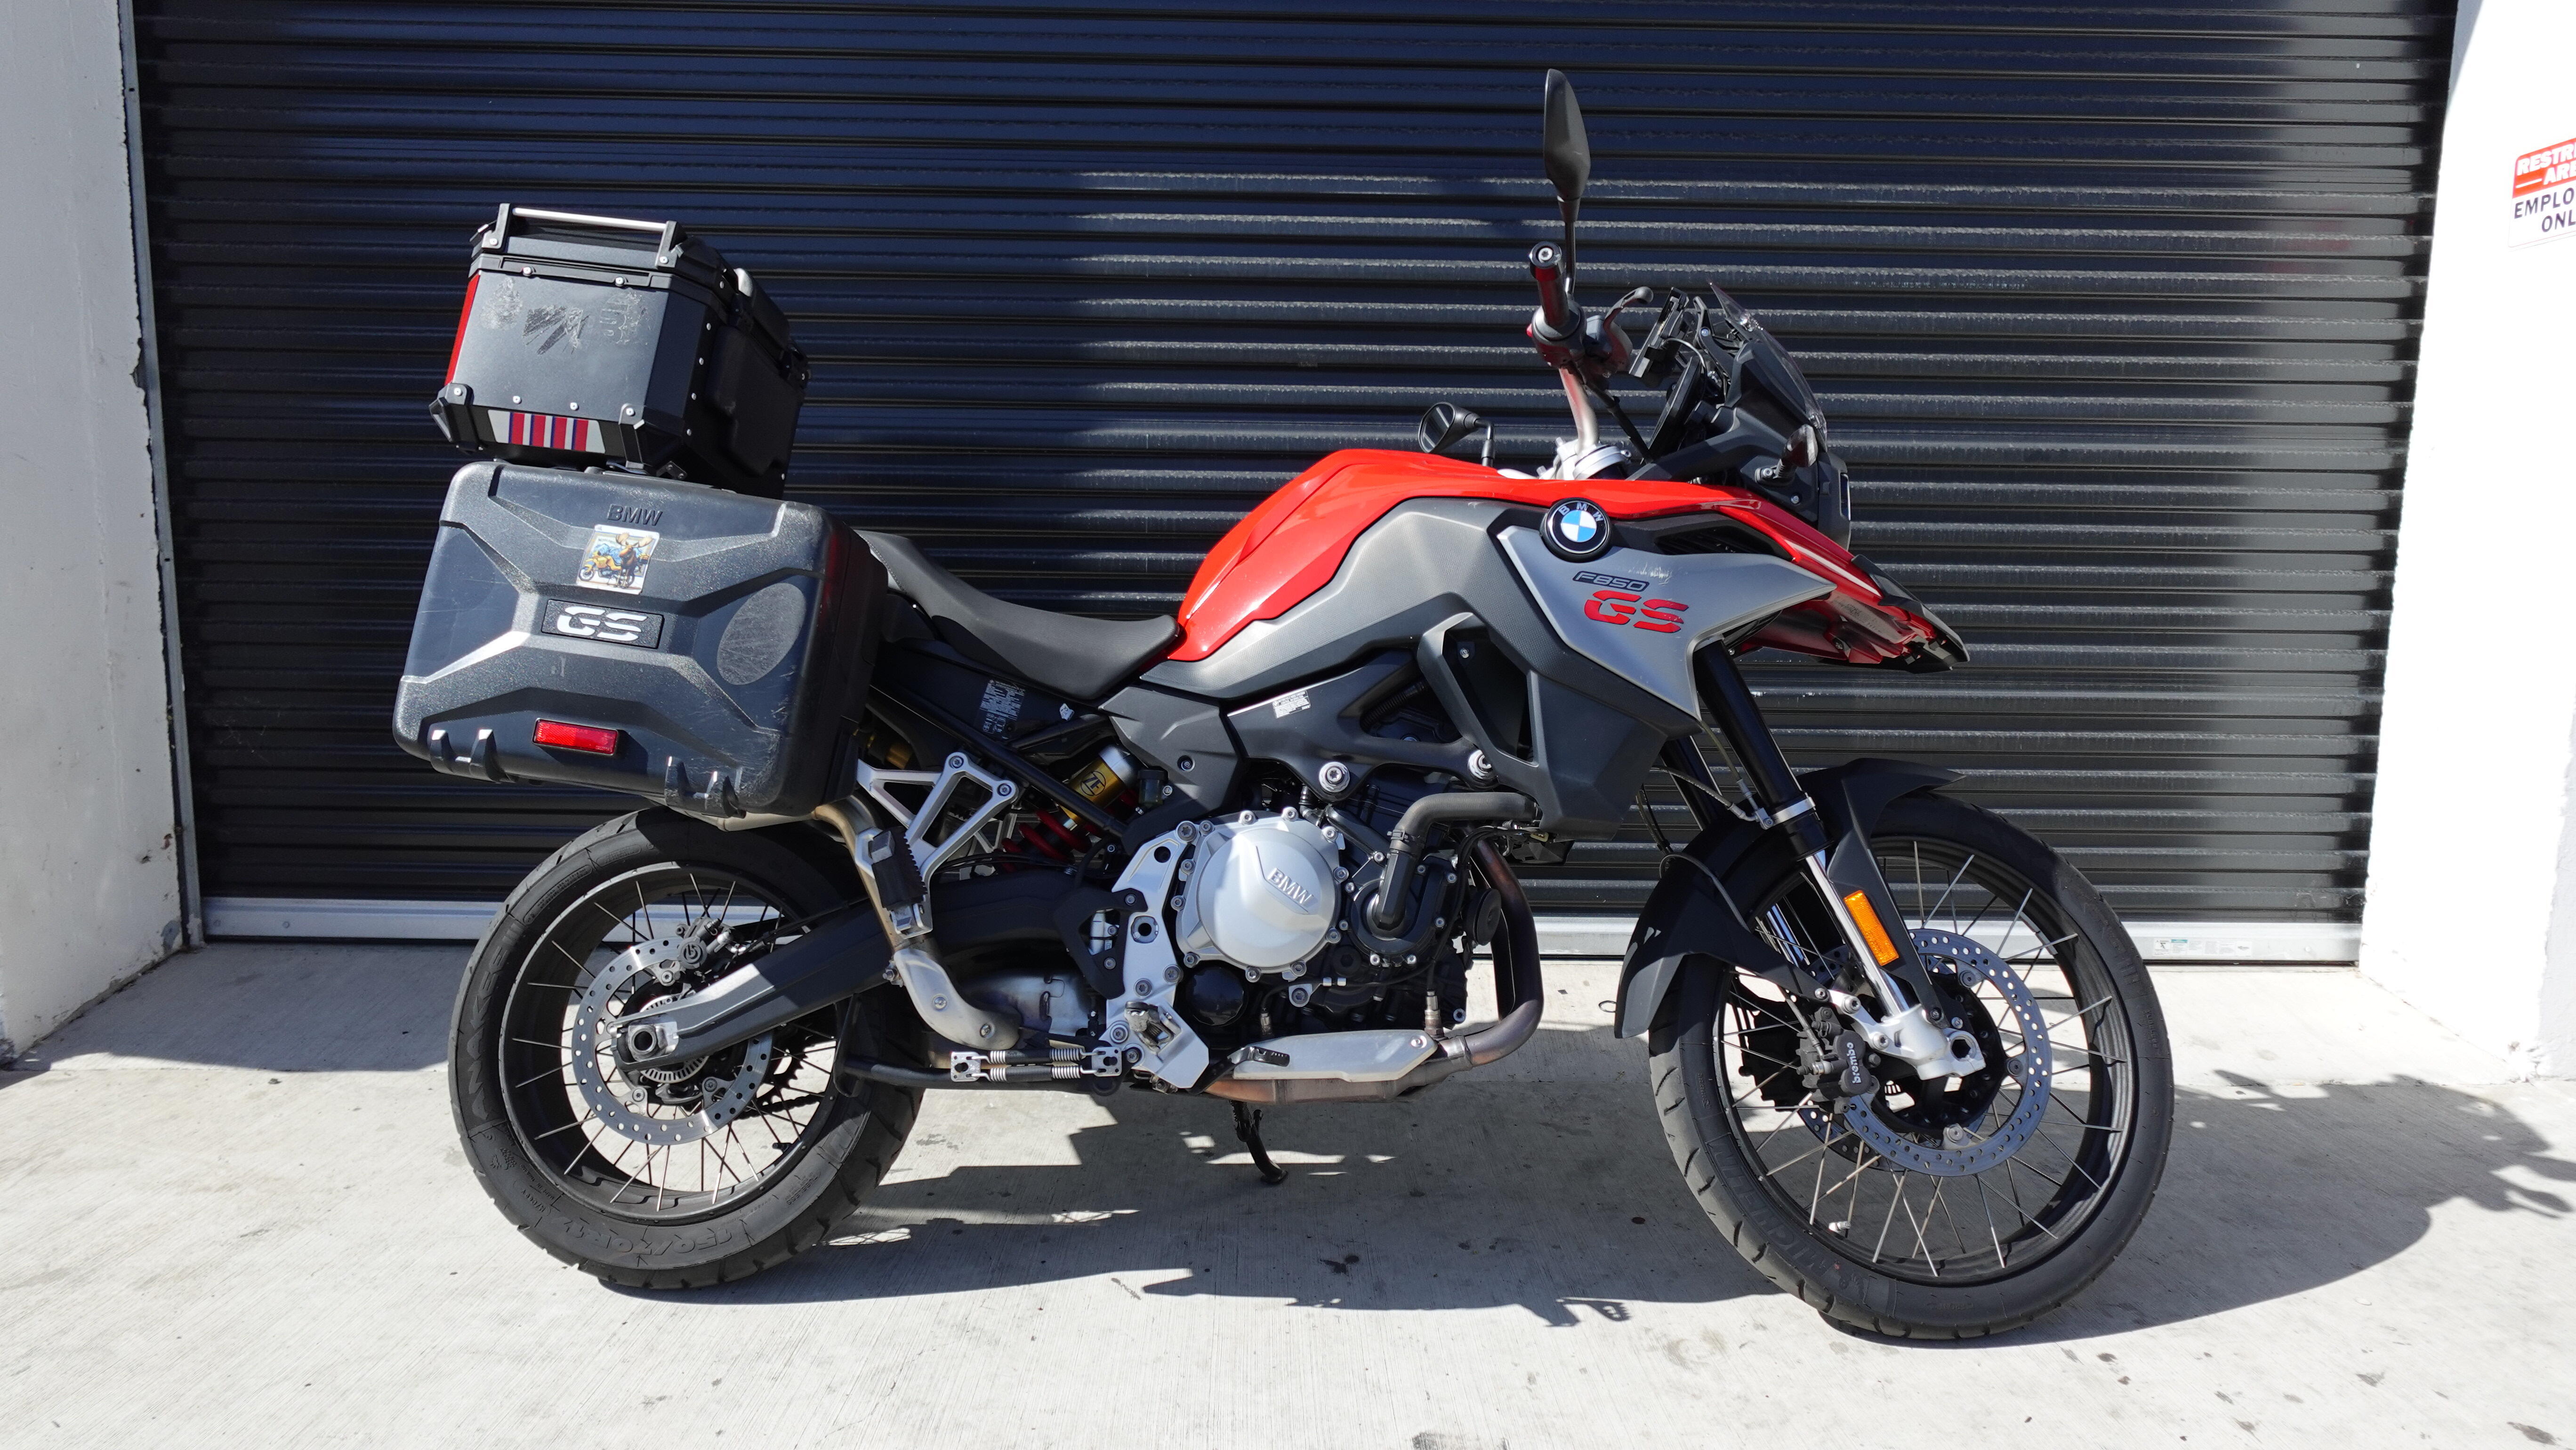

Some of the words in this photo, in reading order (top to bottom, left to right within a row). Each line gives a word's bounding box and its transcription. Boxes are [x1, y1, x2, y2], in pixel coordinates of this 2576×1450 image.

[2514, 187, 2574, 219] EMPLO
[2541, 209, 2576, 232] ONL
[607, 504, 663, 526] BMW
[1558, 502, 1604, 522] BMW
[1576, 573, 1647, 590] F850
[557, 606, 647, 641] GS
[1584, 590, 1689, 633] GS
[1267, 868, 1314, 904] BMW
[467, 945, 509, 1120] ANAKEE
[1846, 1042, 1862, 1084] brembo
